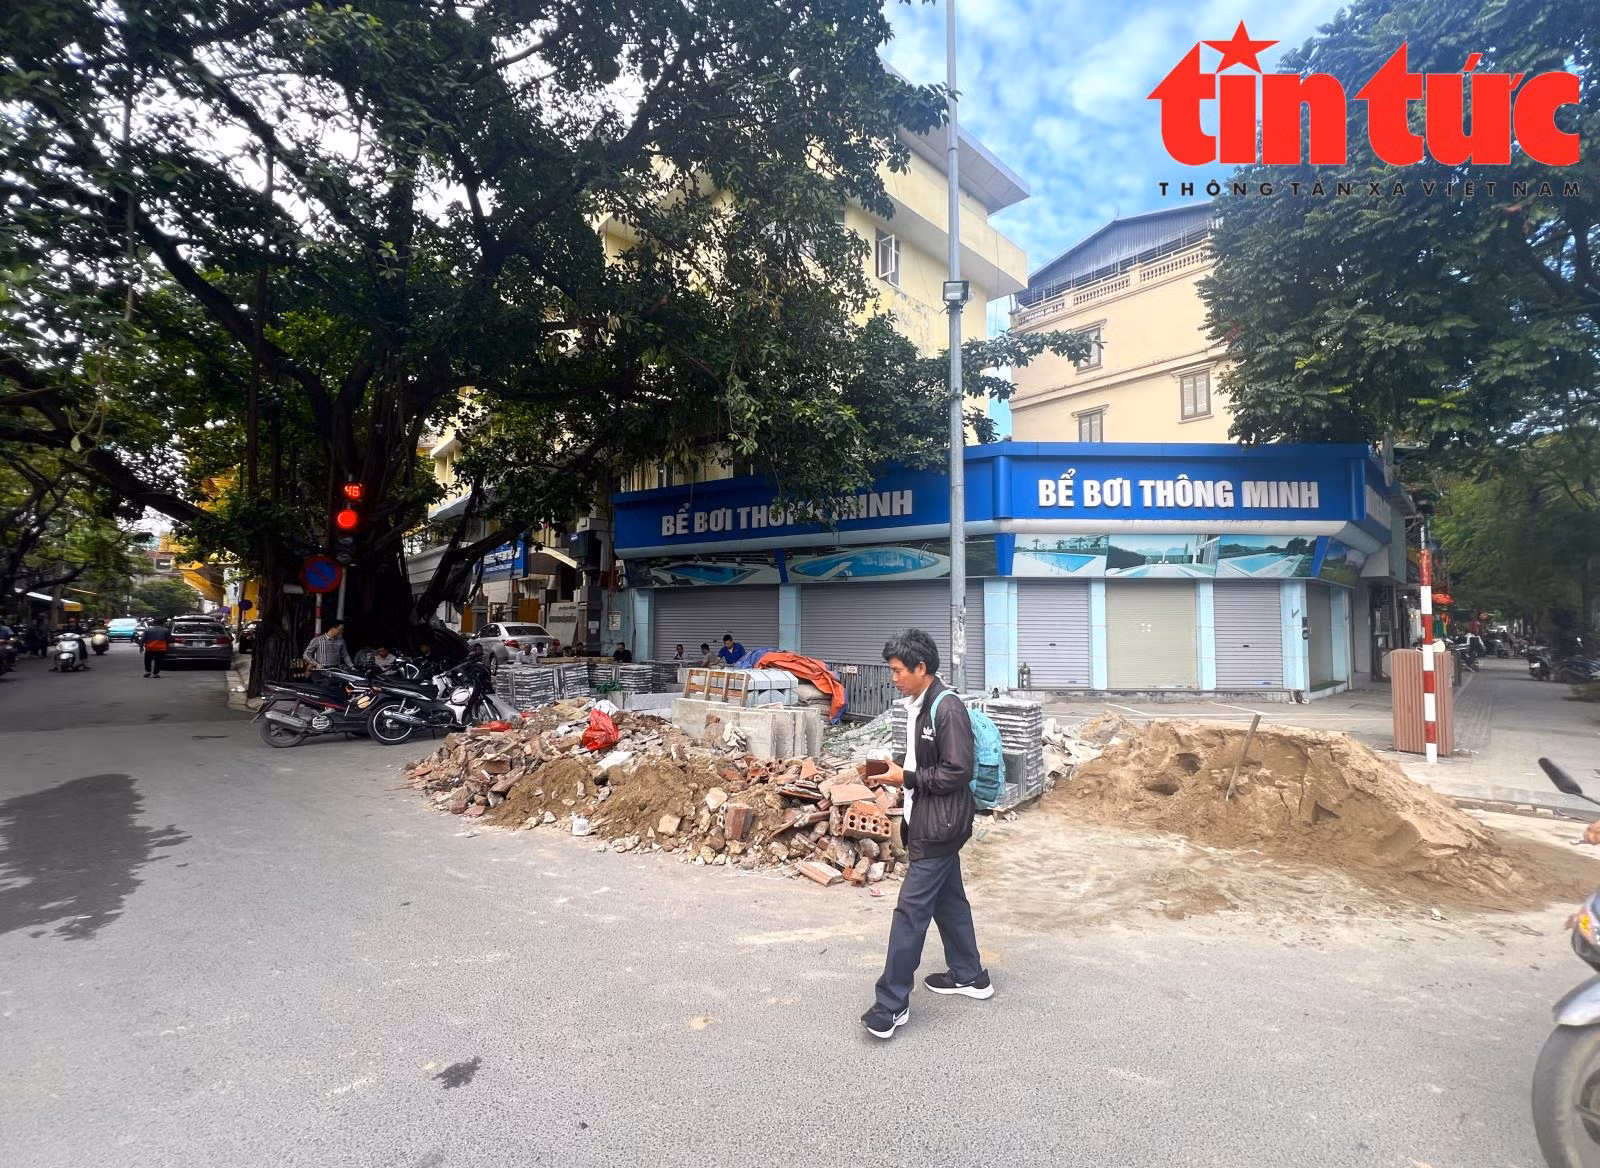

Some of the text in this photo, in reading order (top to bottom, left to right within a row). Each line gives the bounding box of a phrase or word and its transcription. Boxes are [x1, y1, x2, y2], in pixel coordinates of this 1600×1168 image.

[1038, 468, 1320, 508] BỂ BƠI THÔNG MINH
[661, 502, 689, 536] BỂ
[694, 506, 733, 533] BƠI
